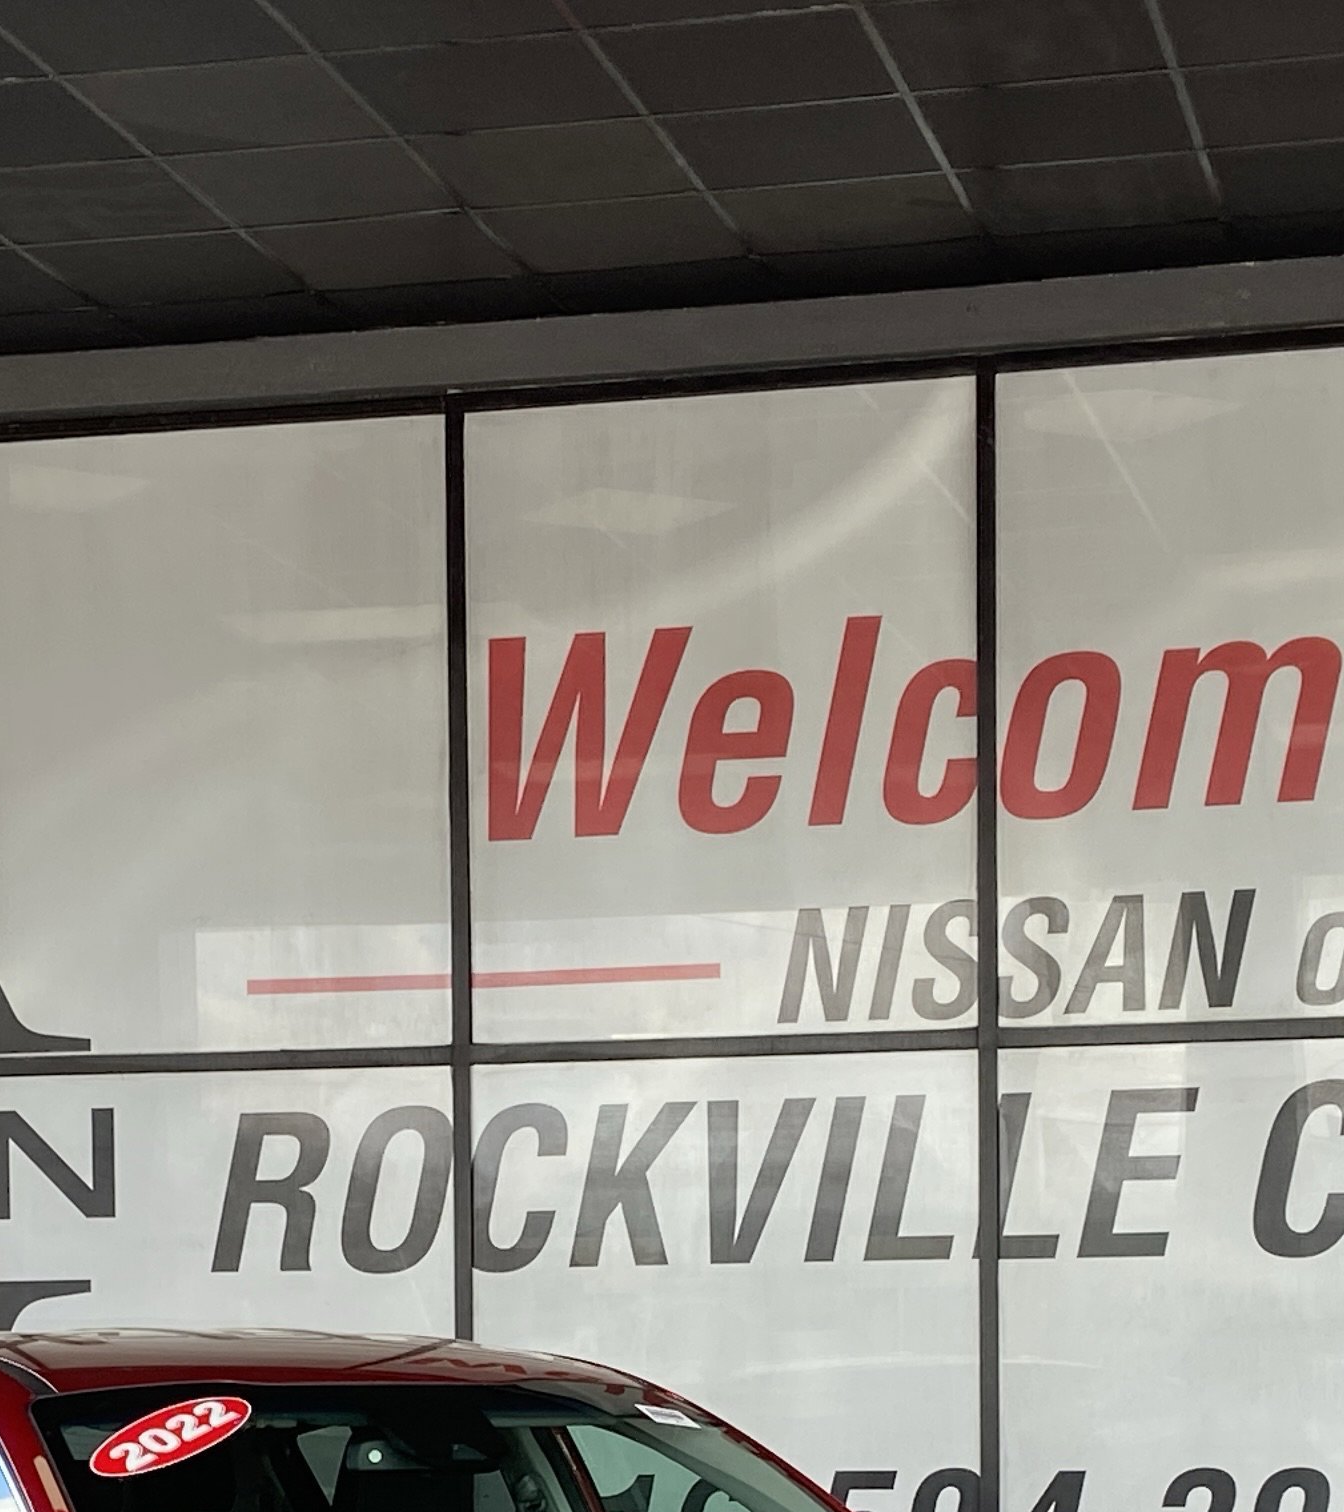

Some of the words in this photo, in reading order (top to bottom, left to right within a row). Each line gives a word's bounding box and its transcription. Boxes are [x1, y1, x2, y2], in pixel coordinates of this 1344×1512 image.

[778, 888, 1256, 1024] NISSAN
[211, 1087, 1199, 1274] ROCKVILLE
[109, 1400, 243, 1472] 2022
